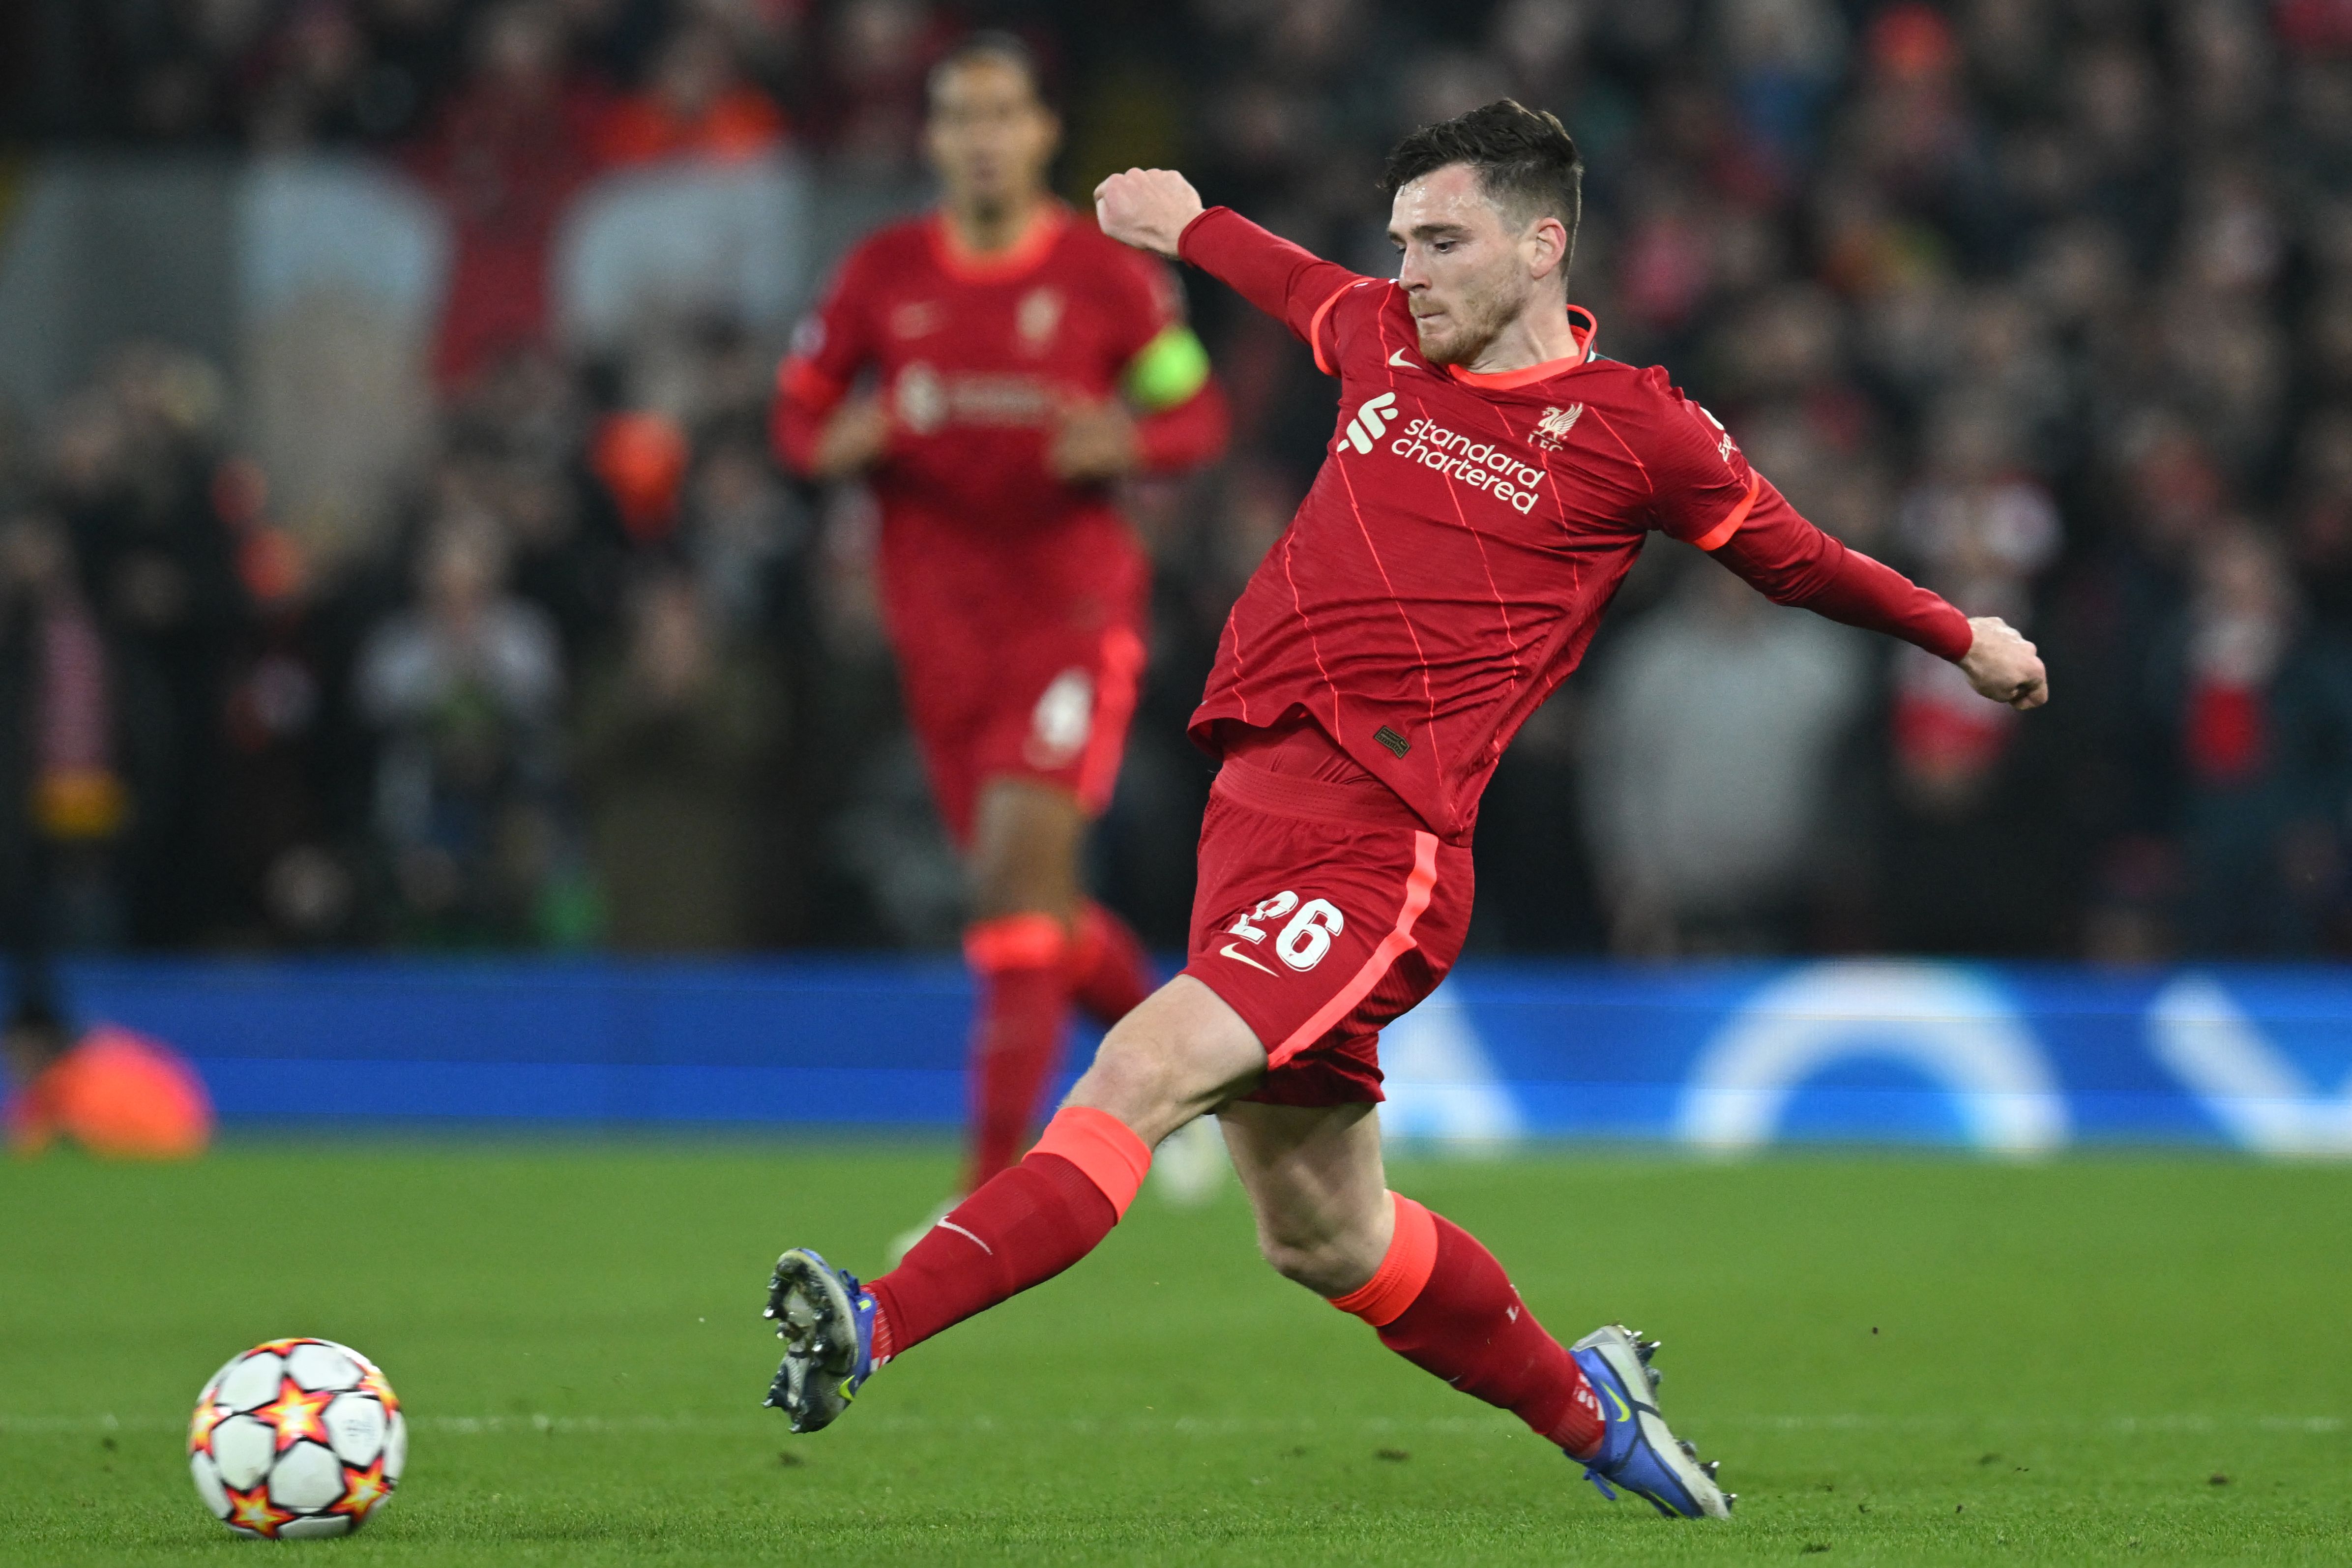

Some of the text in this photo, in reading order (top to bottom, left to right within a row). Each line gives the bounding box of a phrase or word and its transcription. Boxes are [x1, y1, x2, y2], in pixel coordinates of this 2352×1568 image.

[1391, 439, 1539, 514] chartered
[1404, 419, 1546, 489] standard
[1227, 890, 1344, 972] 26
